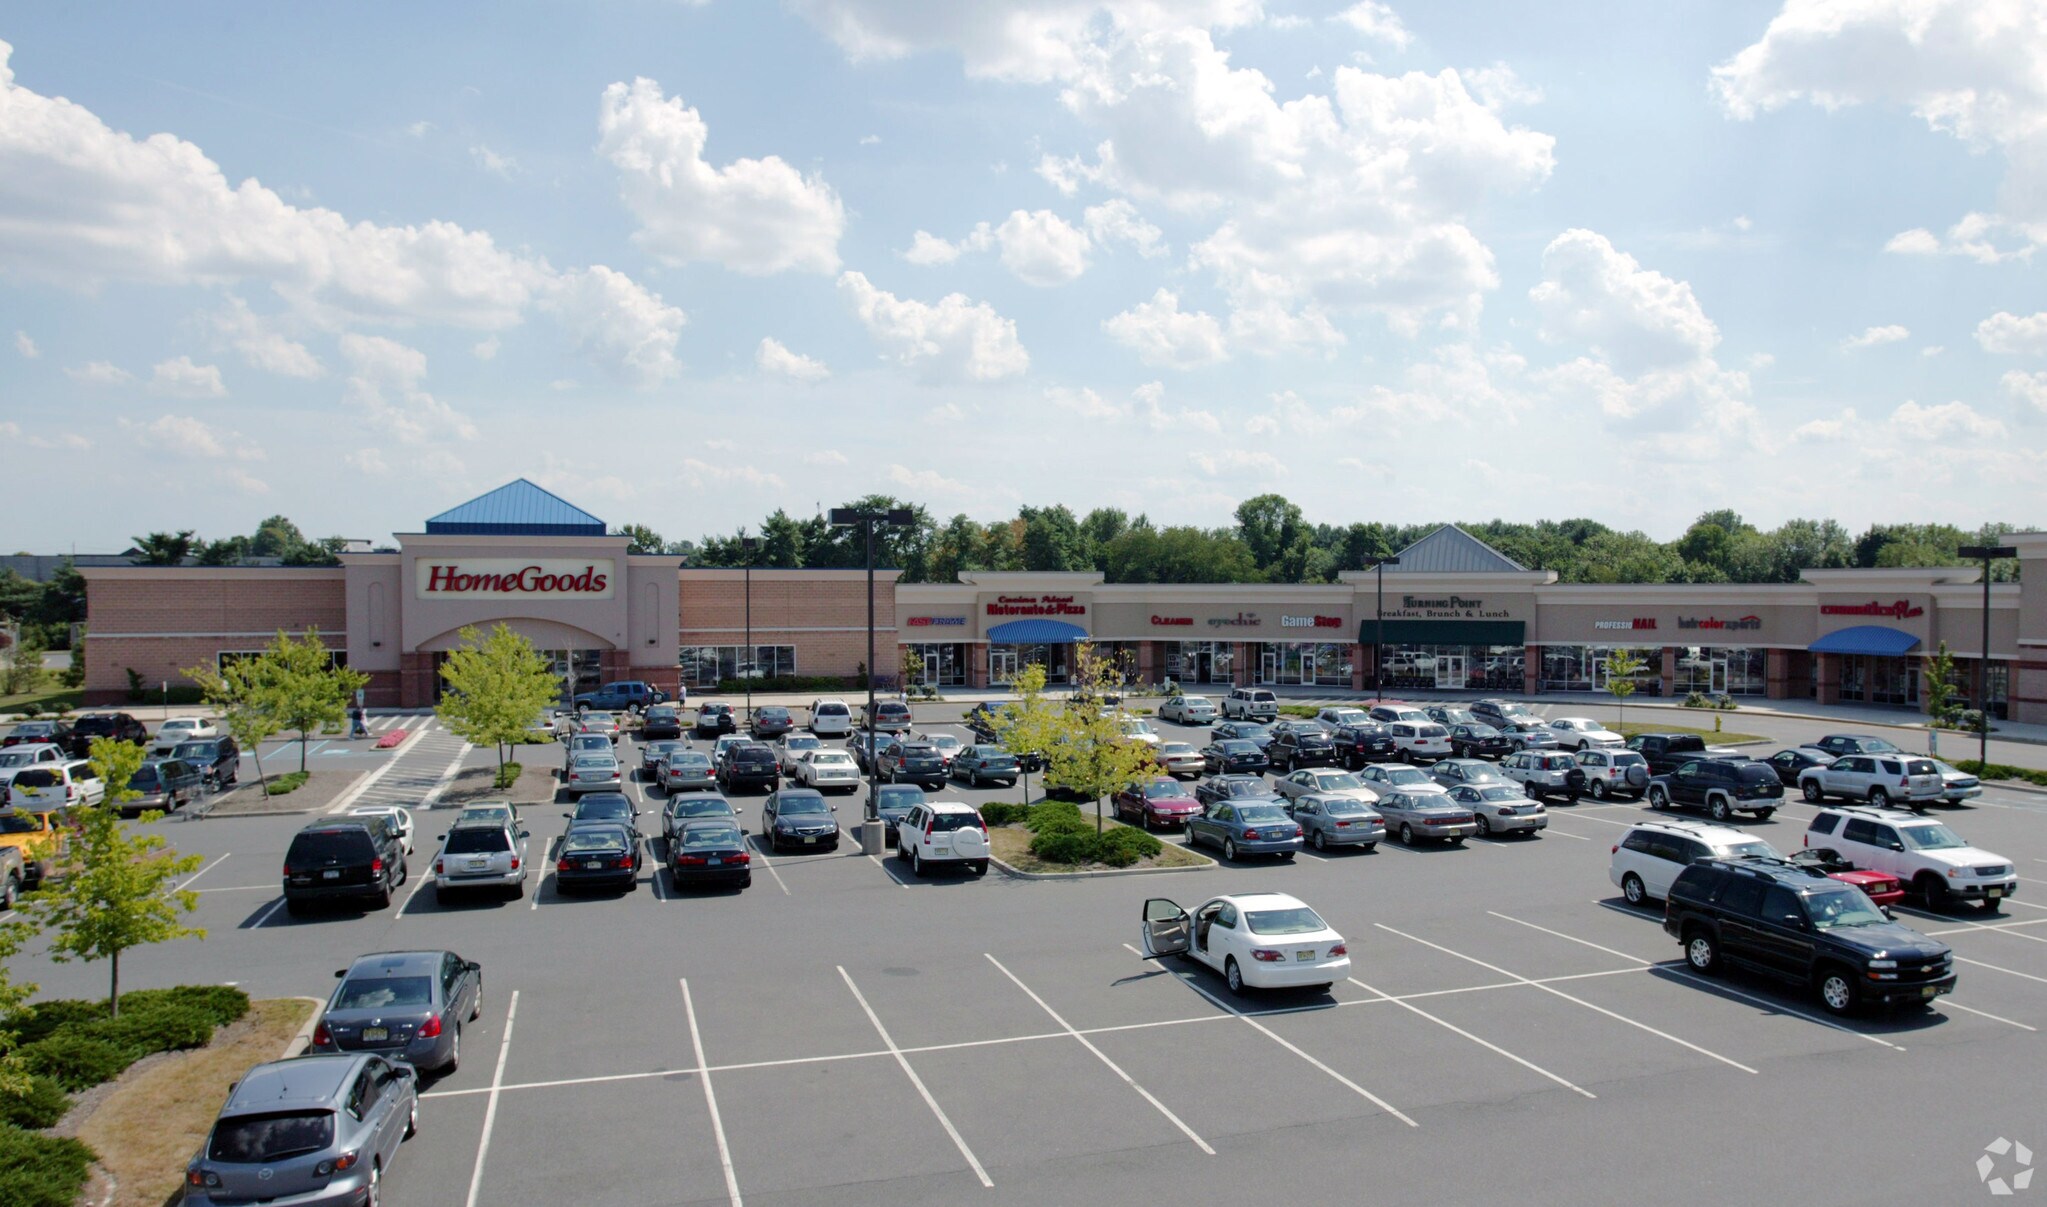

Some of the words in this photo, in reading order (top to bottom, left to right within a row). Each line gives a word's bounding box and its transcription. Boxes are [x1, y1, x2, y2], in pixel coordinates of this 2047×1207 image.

[426, 565, 607, 592] HomeGoods
[1450, 596, 1482, 608] POINT
[1281, 615, 1342, 628] GameStop
